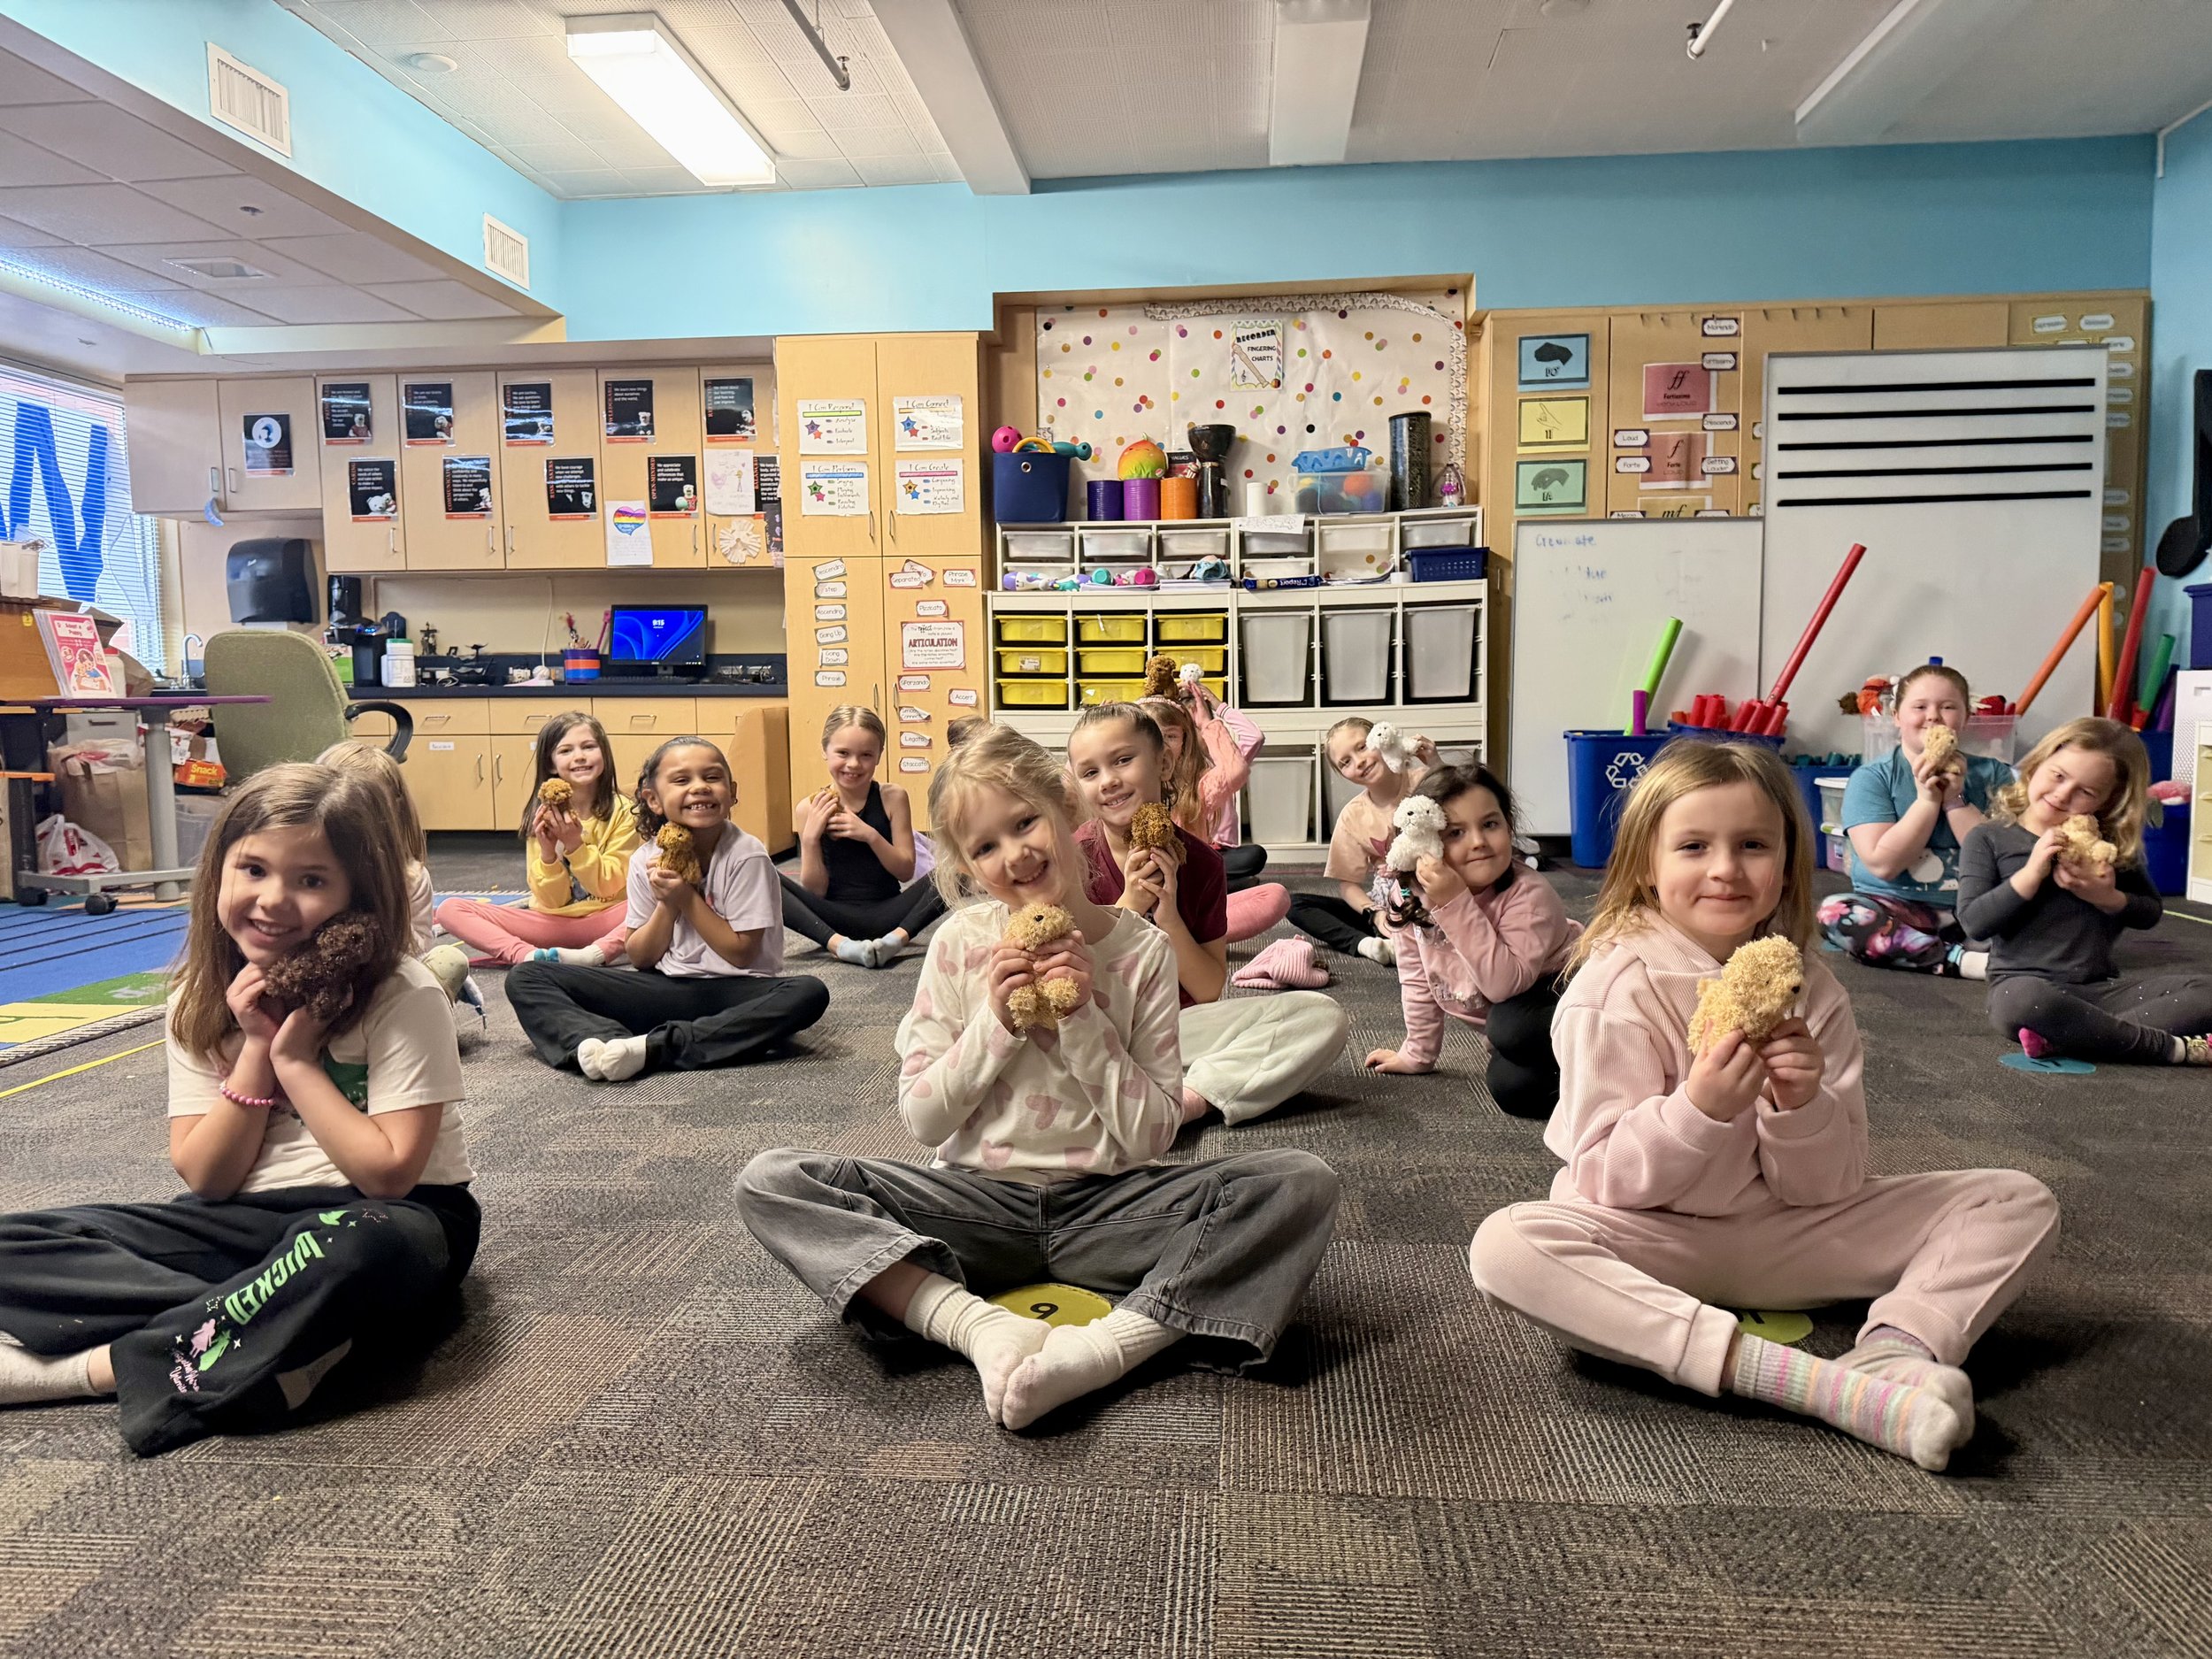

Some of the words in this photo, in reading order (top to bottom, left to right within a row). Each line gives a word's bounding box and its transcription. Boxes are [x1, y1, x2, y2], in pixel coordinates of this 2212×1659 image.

[1236, 329, 1276, 343] RECORDER
[818, 631, 834, 640] Going
[908, 638, 958, 648] ARTICULATION
[190, 764, 219, 776] Snack
[225, 1231, 326, 1325] WICKED
[1030, 1302, 1059, 1320] 9
